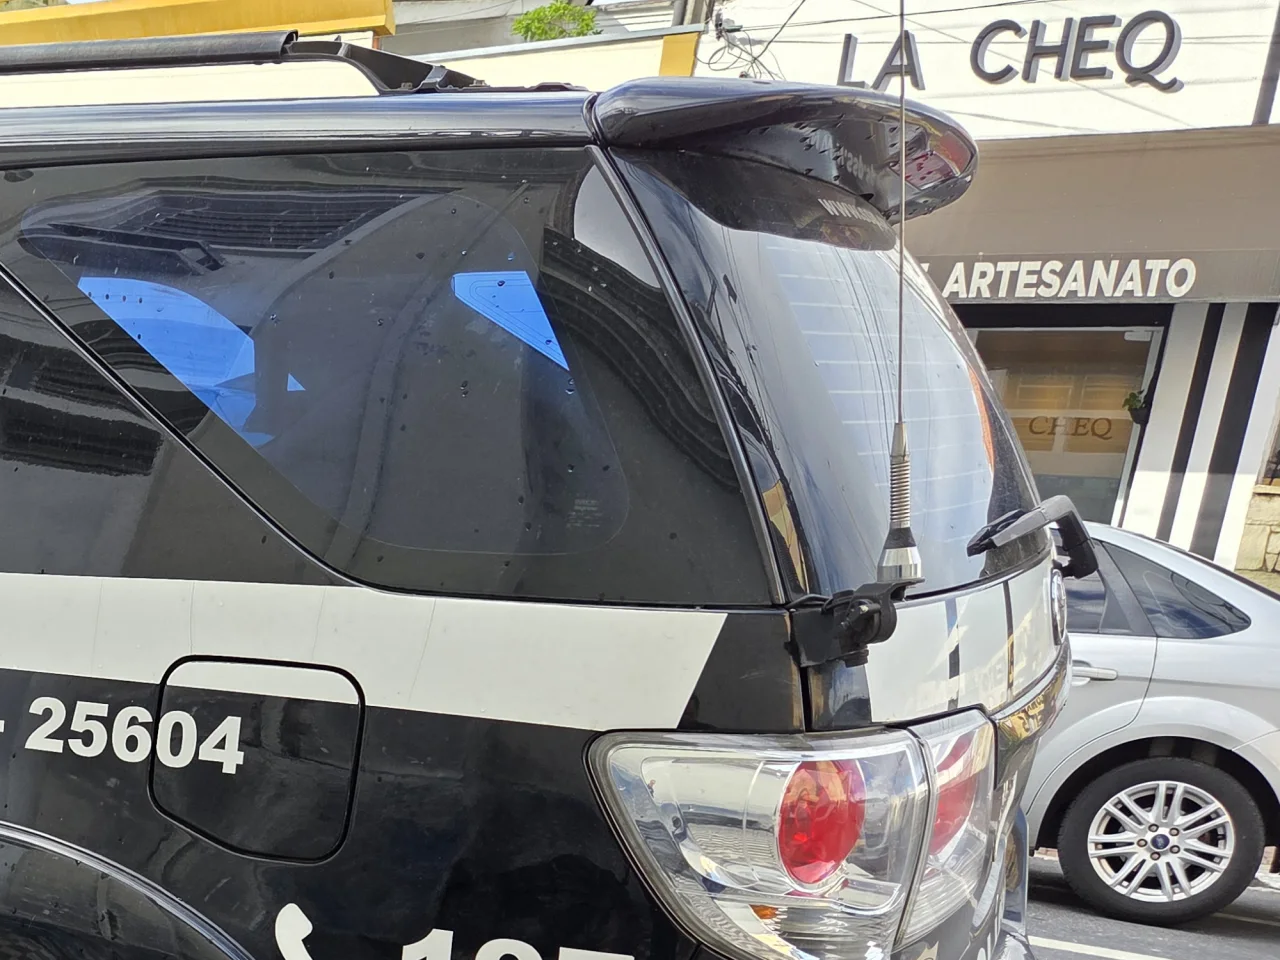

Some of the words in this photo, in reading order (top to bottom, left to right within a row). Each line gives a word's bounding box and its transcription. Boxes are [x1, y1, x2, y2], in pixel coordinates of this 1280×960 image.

[837, 29, 926, 92] LA
[970, 10, 1185, 94] CHEQ
[941, 257, 1197, 299] ARTESANATO
[1028, 415, 1113, 440] CHEQ
[24, 696, 245, 774] 25604
